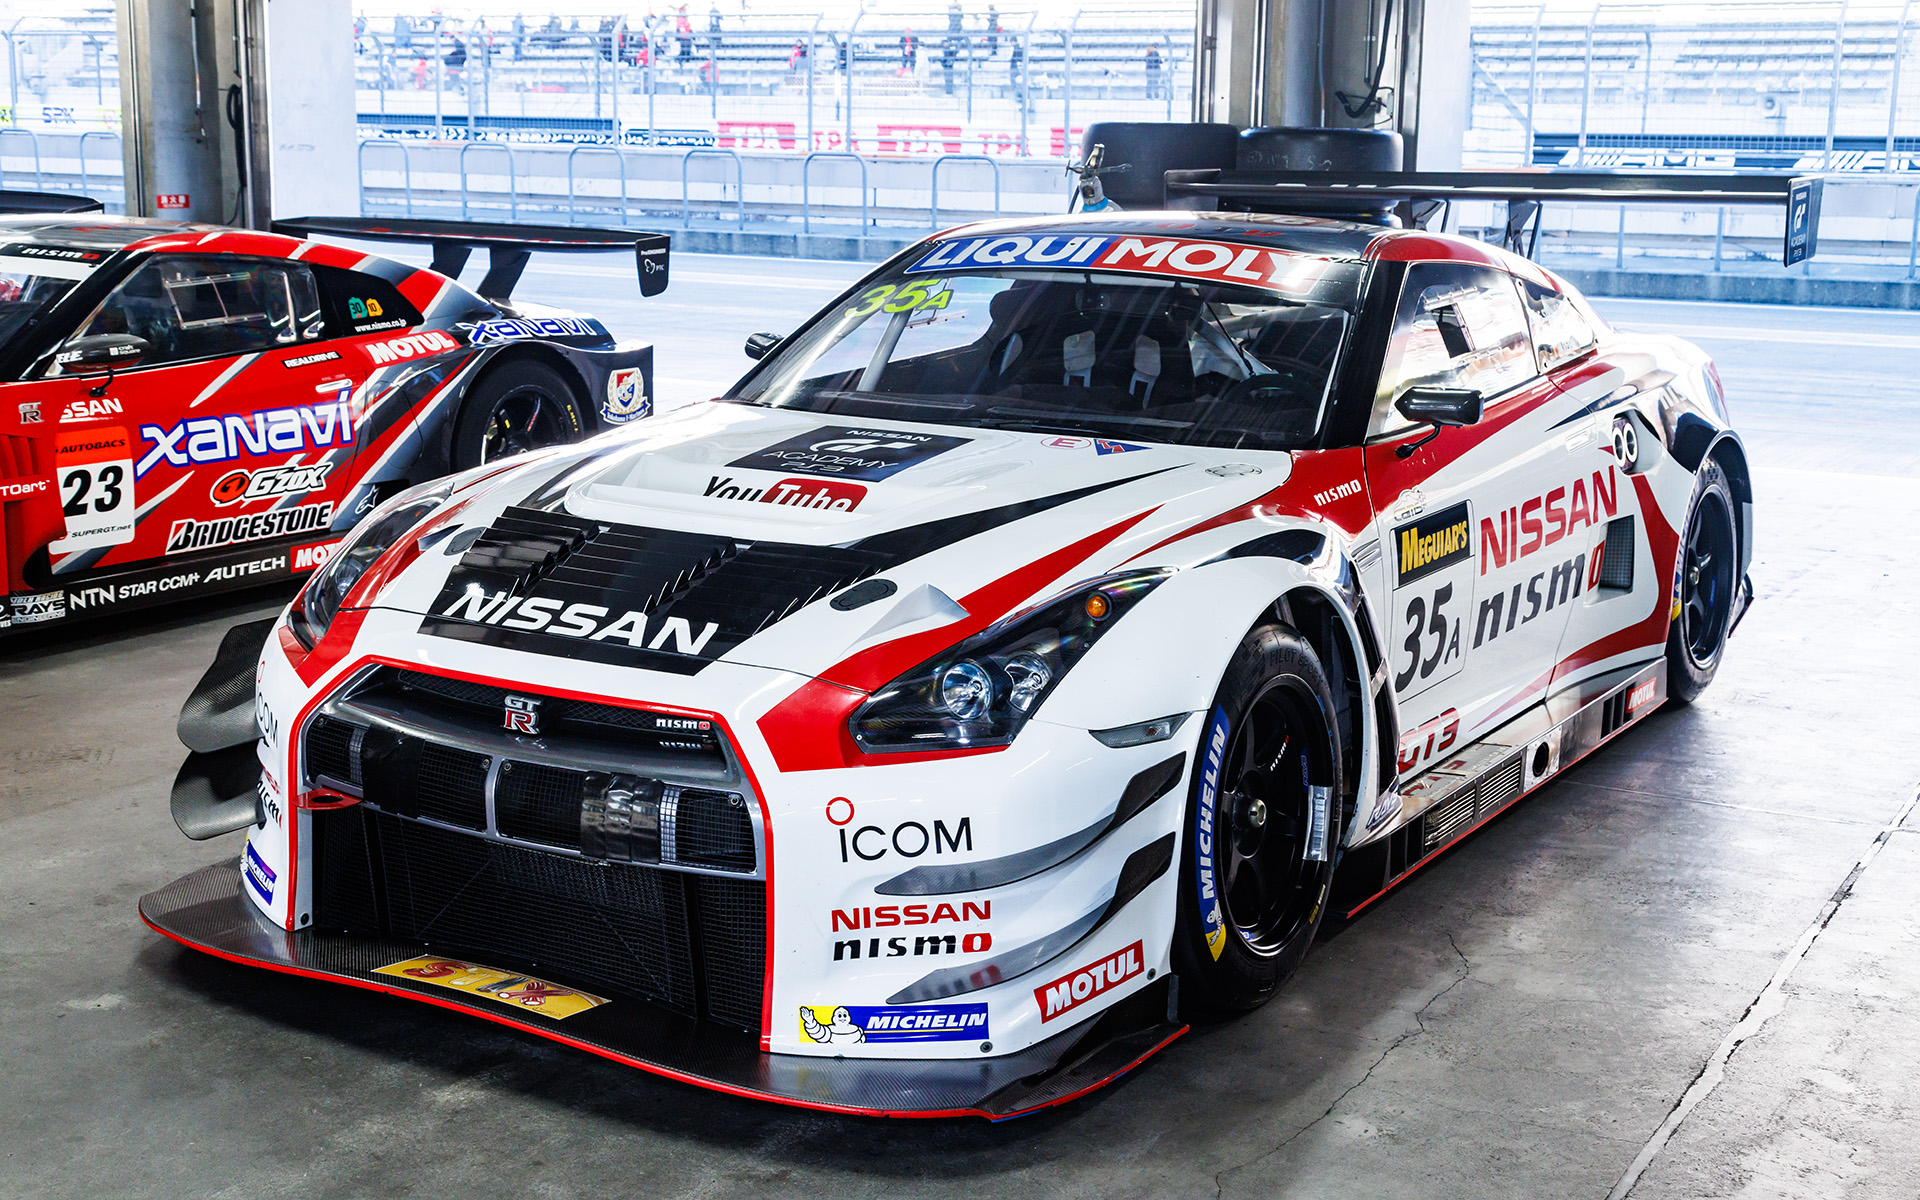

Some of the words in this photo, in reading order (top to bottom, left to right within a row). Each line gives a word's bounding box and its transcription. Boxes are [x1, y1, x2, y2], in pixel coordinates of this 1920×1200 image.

[21, 247, 100, 260] nismo
[922, 236, 1102, 266] LIQUI
[1102, 237, 1316, 291] MOLY
[349, 302, 362, 314] 30
[368, 302, 378, 313] 10
[845, 278, 954, 318] 35A
[354, 318, 407, 333] www.nismo.co.jp
[284, 353, 339, 368] REALDRIVE
[365, 331, 455, 365] MOTUL
[20, 410, 44, 424] R
[60, 439, 125, 453] AUTOBACS
[847, 429, 931, 442] NISSAN
[762, 450, 899, 469] ACADEMY
[62, 465, 124, 517] 23
[1313, 479, 1362, 506] nismo
[71, 524, 131, 538] SUPERGT.net
[166, 503, 332, 553] BRIDGESTONE
[1480, 464, 1617, 577] NISSAN
[203, 556, 286, 583] AUTECH
[70, 585, 115, 610] NTN
[118, 580, 157, 598] STAR
[159, 572, 201, 591] CCM+
[440, 588, 720, 655] NISSAN
[1394, 581, 1460, 693] 35A
[505, 695, 541, 711] GT
[1628, 680, 1655, 710] MOTUL
[503, 708, 538, 734] R
[656, 718, 710, 730] nismo
[1200, 723, 1227, 900] MICHELIN
[831, 900, 991, 933] NISSAN
[833, 932, 993, 961] nismo
[1046, 949, 1141, 1017] MOTUL
[866, 1013, 987, 1030] MICHELIN
